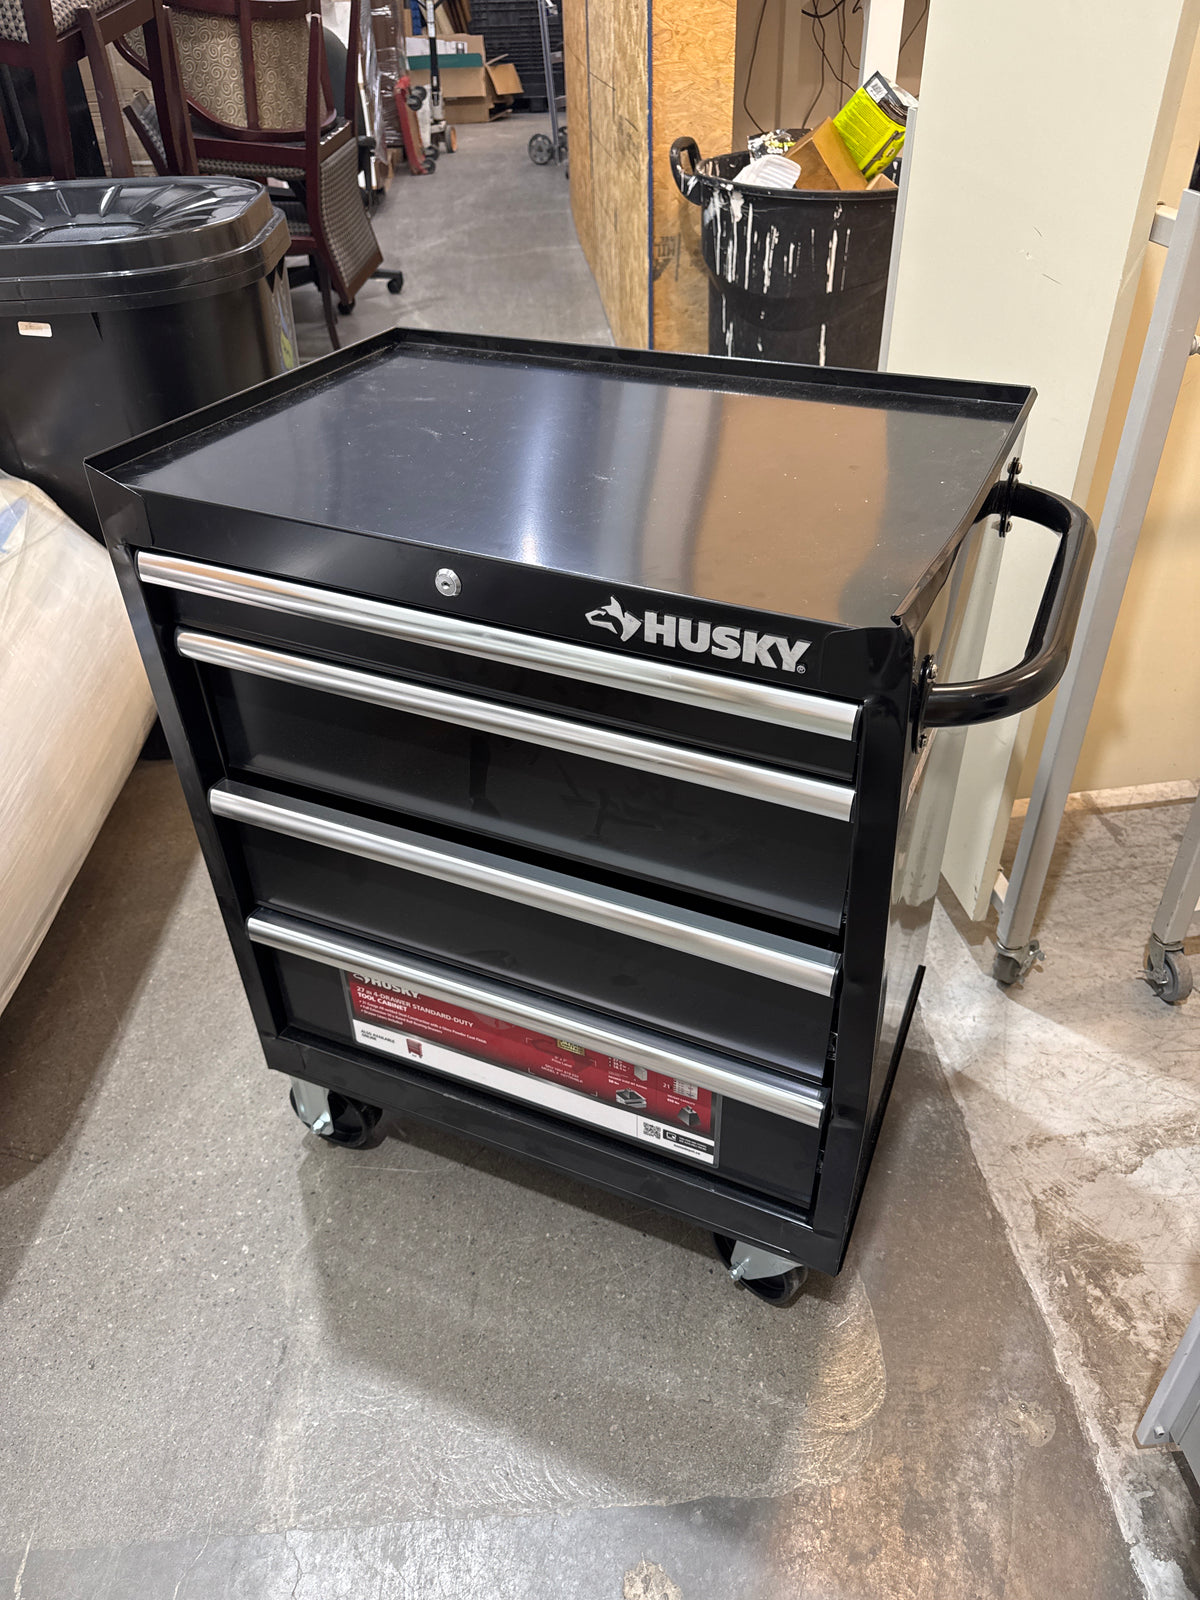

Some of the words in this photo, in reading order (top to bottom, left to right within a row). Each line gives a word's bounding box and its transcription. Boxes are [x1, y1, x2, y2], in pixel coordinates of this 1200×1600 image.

[644, 610, 813, 673] HUSKY
[357, 992, 376, 1003] TOOL
[377, 998, 407, 1012] CABINET
[374, 990, 411, 1008] 4-DRAWER
[412, 1002, 474, 1028] STANDARD-DUTY
